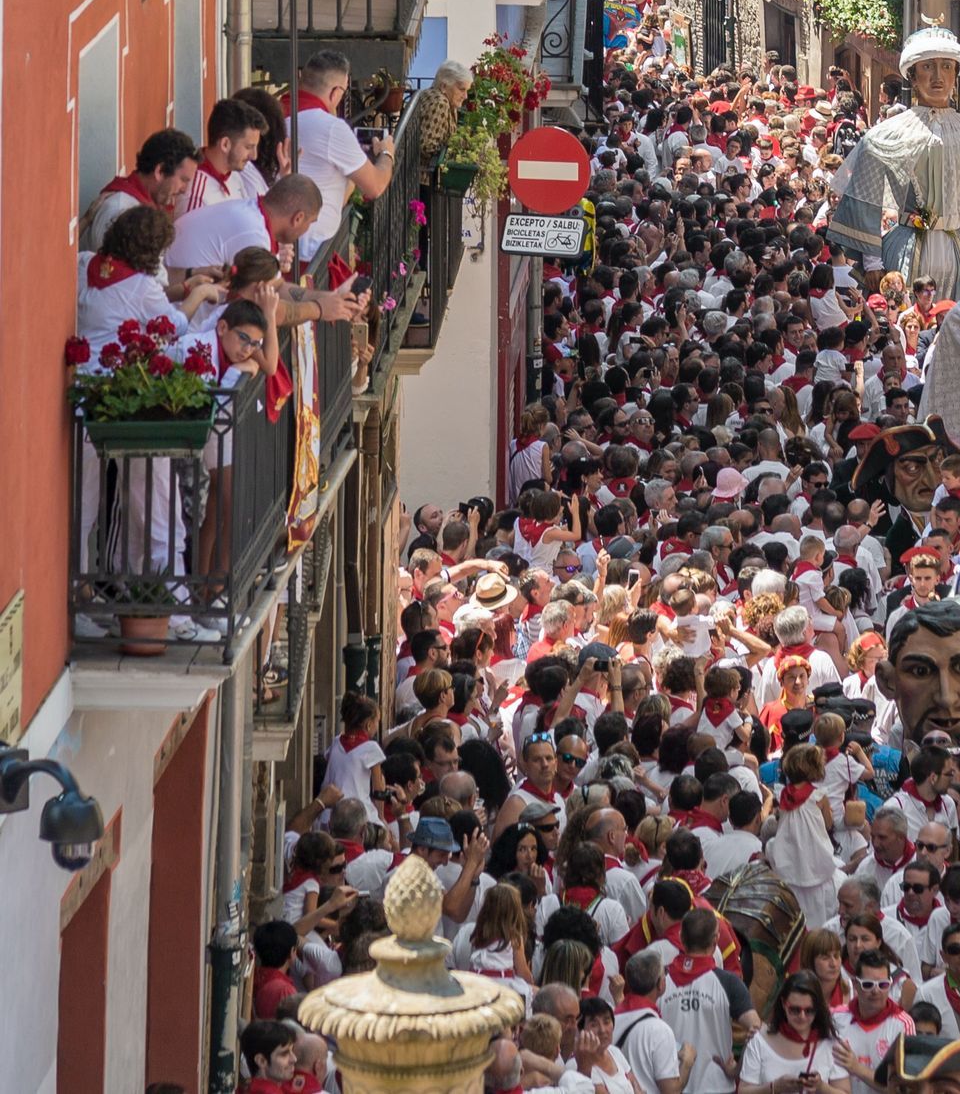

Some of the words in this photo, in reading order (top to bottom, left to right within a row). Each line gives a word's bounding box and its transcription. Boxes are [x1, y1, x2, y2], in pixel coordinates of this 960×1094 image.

[510, 218, 545, 228] EXCEPTO
[506, 228, 546, 238] BICICLETAS
[505, 239, 542, 248] BIZIKLETAK
[681, 998, 700, 1012] 30
